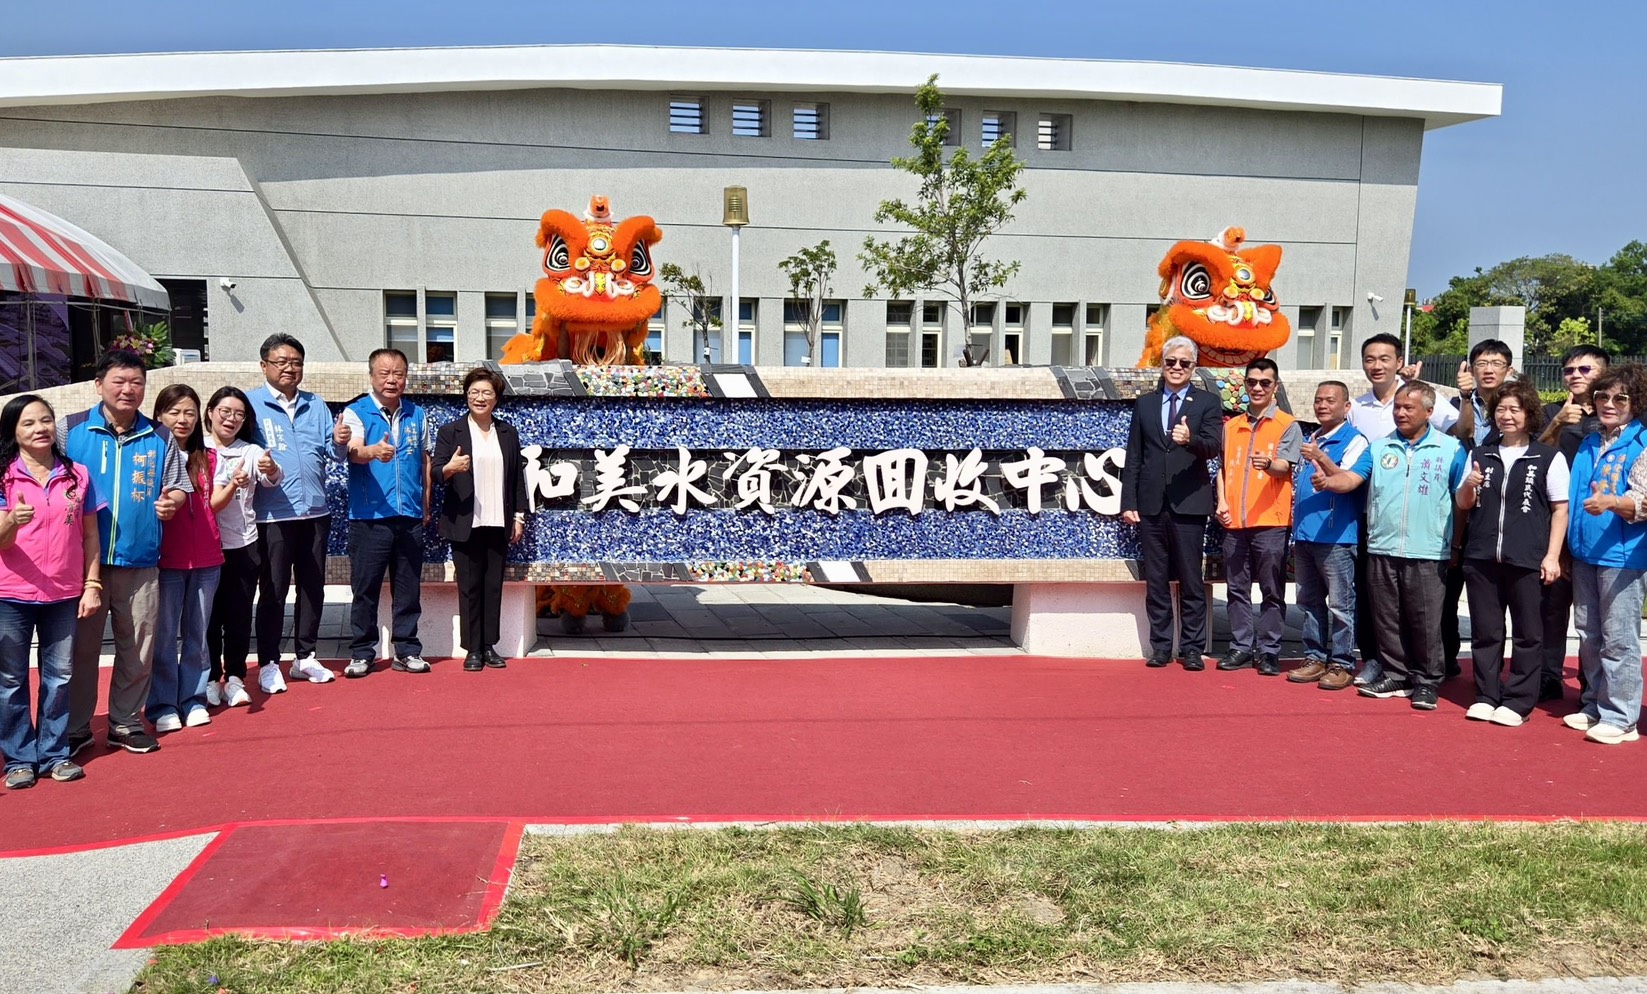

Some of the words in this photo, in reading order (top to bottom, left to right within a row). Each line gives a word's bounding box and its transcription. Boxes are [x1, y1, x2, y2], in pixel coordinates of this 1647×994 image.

[520, 443, 1126, 516] 和美水資源回收中心
